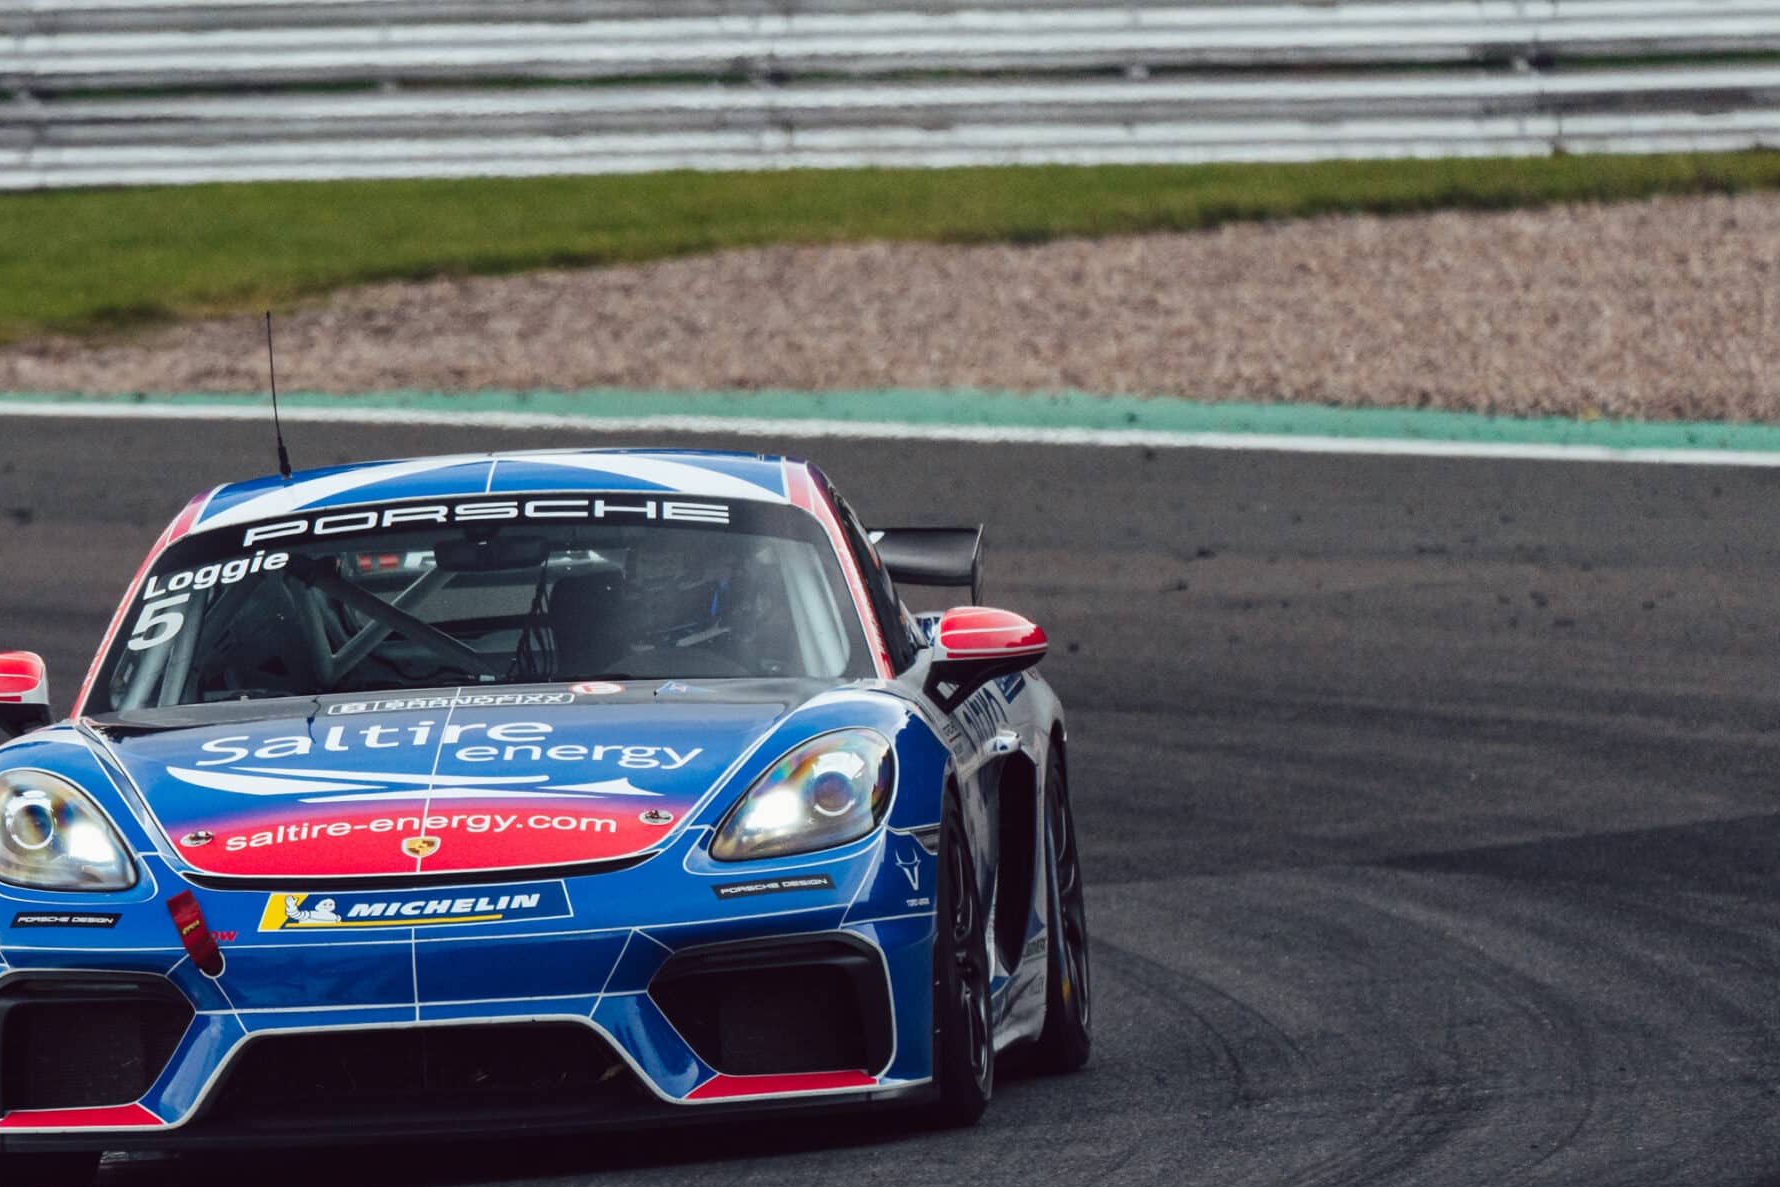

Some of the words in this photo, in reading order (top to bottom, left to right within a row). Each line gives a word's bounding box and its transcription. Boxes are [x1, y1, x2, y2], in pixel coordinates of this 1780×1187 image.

[243, 500, 730, 547] PORSCHE
[143, 550, 290, 600] Loggie
[127, 593, 190, 651] 5
[455, 744, 704, 769] energy
[225, 813, 617, 852] saltire-energy.com
[720, 881, 780, 895] PORSCHE
[781, 877, 829, 888] DESIGN
[17, 915, 70, 924] PORSCHE
[71, 915, 115, 924] DESIGN
[347, 893, 541, 918] MICHELIN
